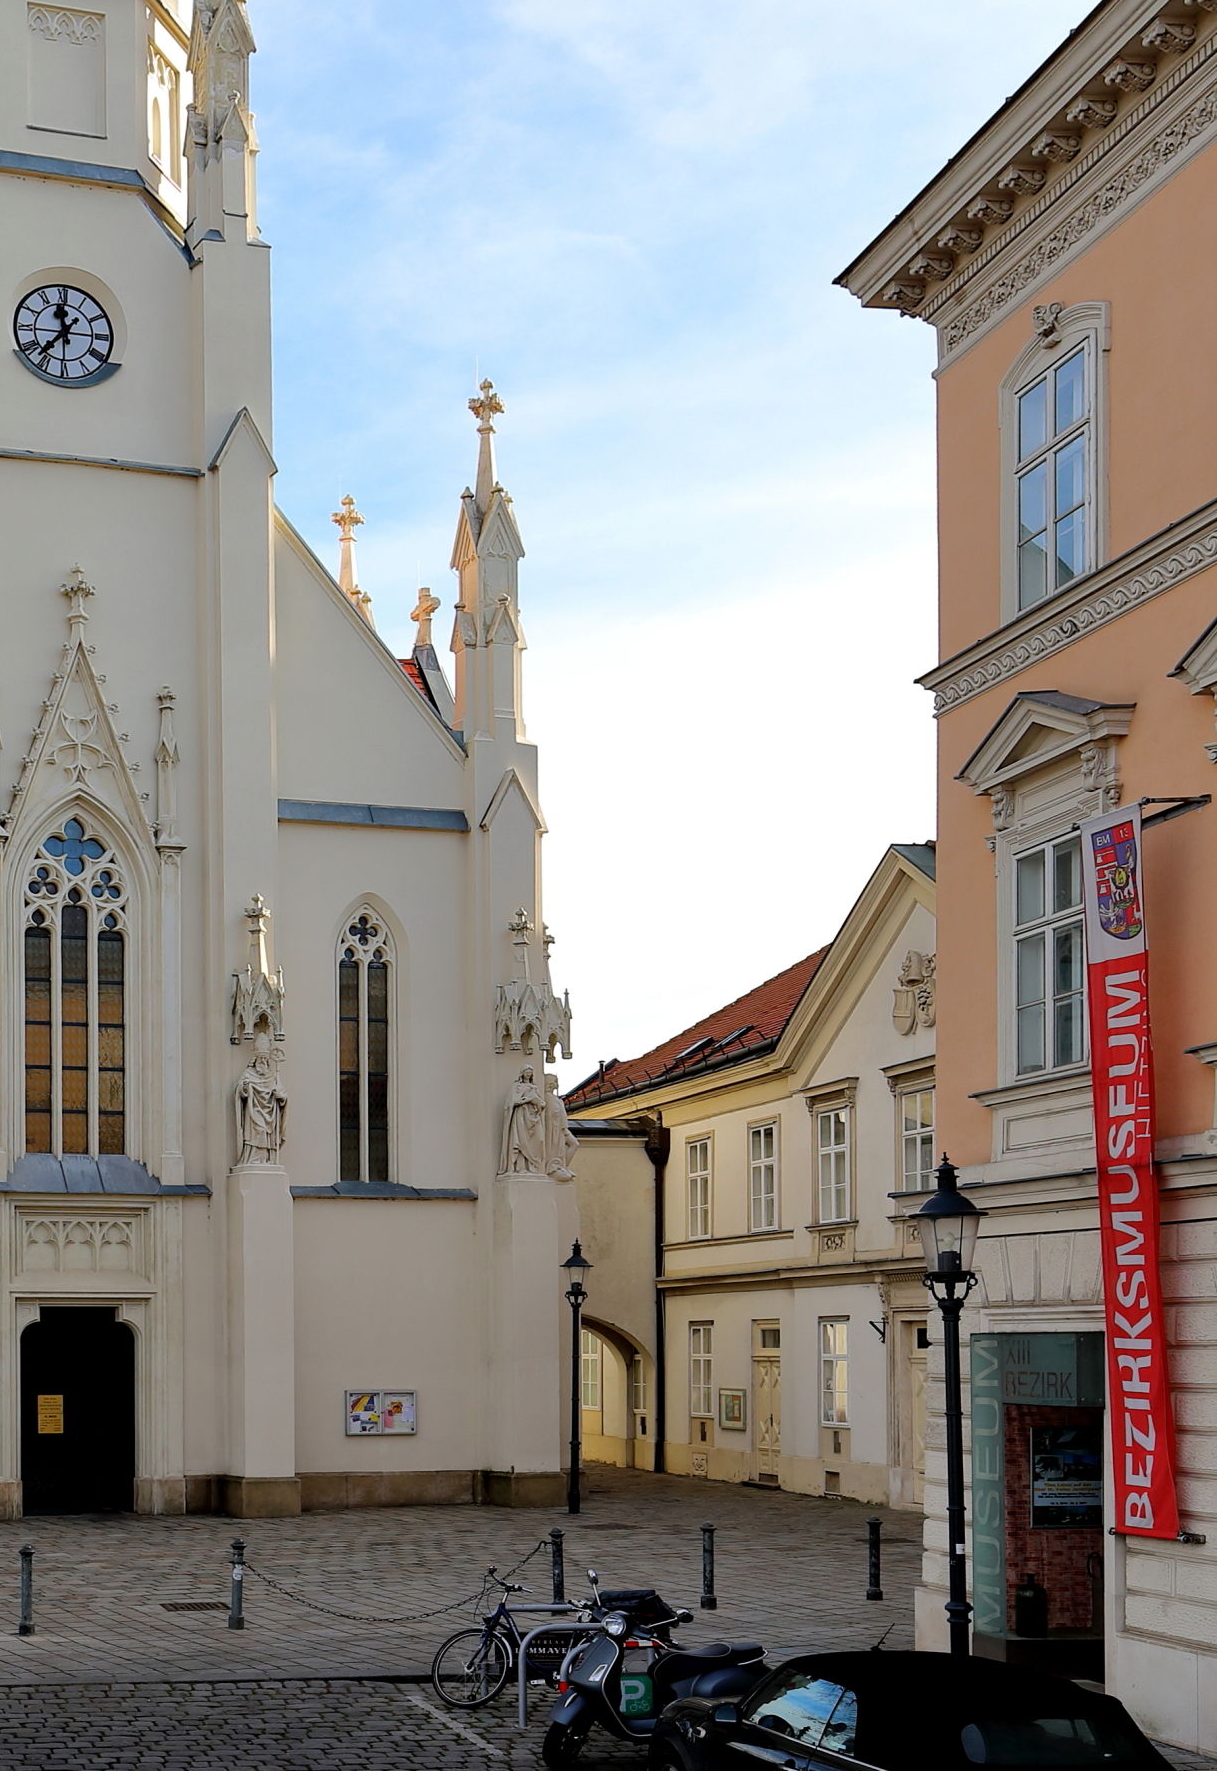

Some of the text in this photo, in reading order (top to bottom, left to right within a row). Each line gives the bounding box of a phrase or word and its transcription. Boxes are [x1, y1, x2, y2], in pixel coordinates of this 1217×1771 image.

[1096, 834, 1111, 847] BM
[1104, 970, 1156, 1529] BEZIRKSMUSEUM
[1005, 1339, 1031, 1365] XIII
[1005, 1371, 1074, 1399] BEZIRK
[973, 1339, 1002, 1633] MUSEUM
[619, 1679, 645, 1712] P
